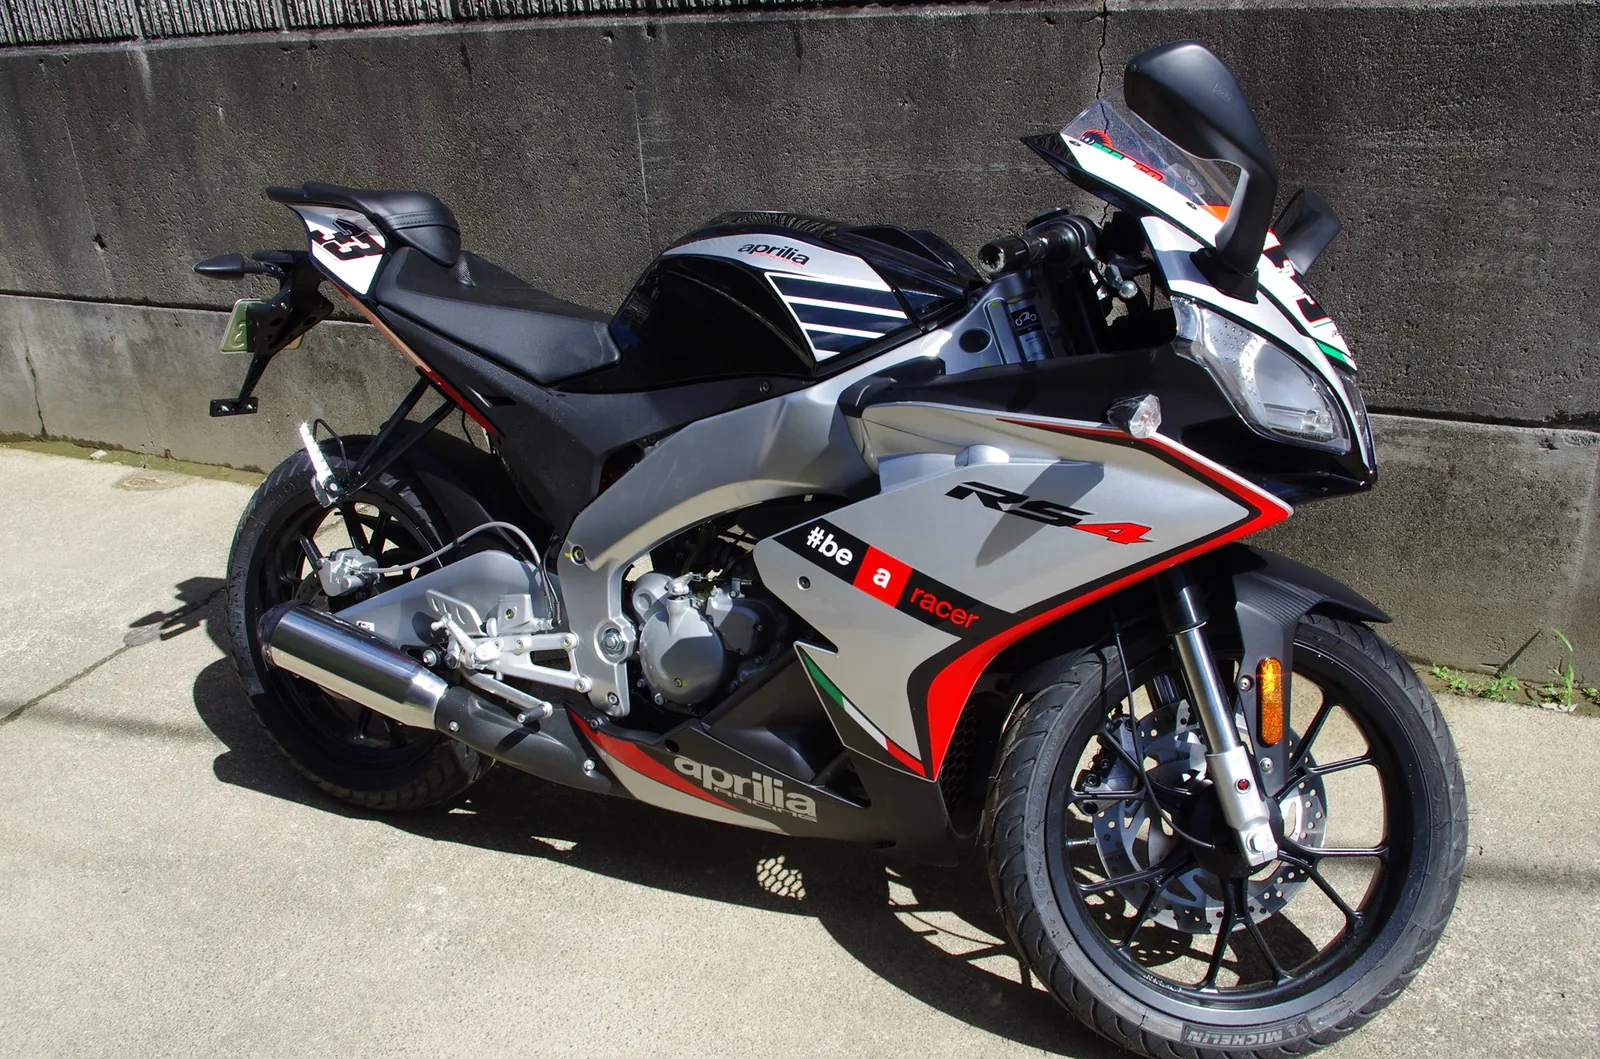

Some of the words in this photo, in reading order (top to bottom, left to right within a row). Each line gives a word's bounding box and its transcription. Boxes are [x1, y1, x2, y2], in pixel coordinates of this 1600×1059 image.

[738, 244, 810, 265] aprilia
[944, 481, 1154, 545] RS4
[807, 526, 853, 566] #be
[872, 567, 891, 589] a
[910, 587, 980, 628] racer
[674, 757, 817, 818] aprilia
[1186, 1029, 1283, 1046] MICHELIN
